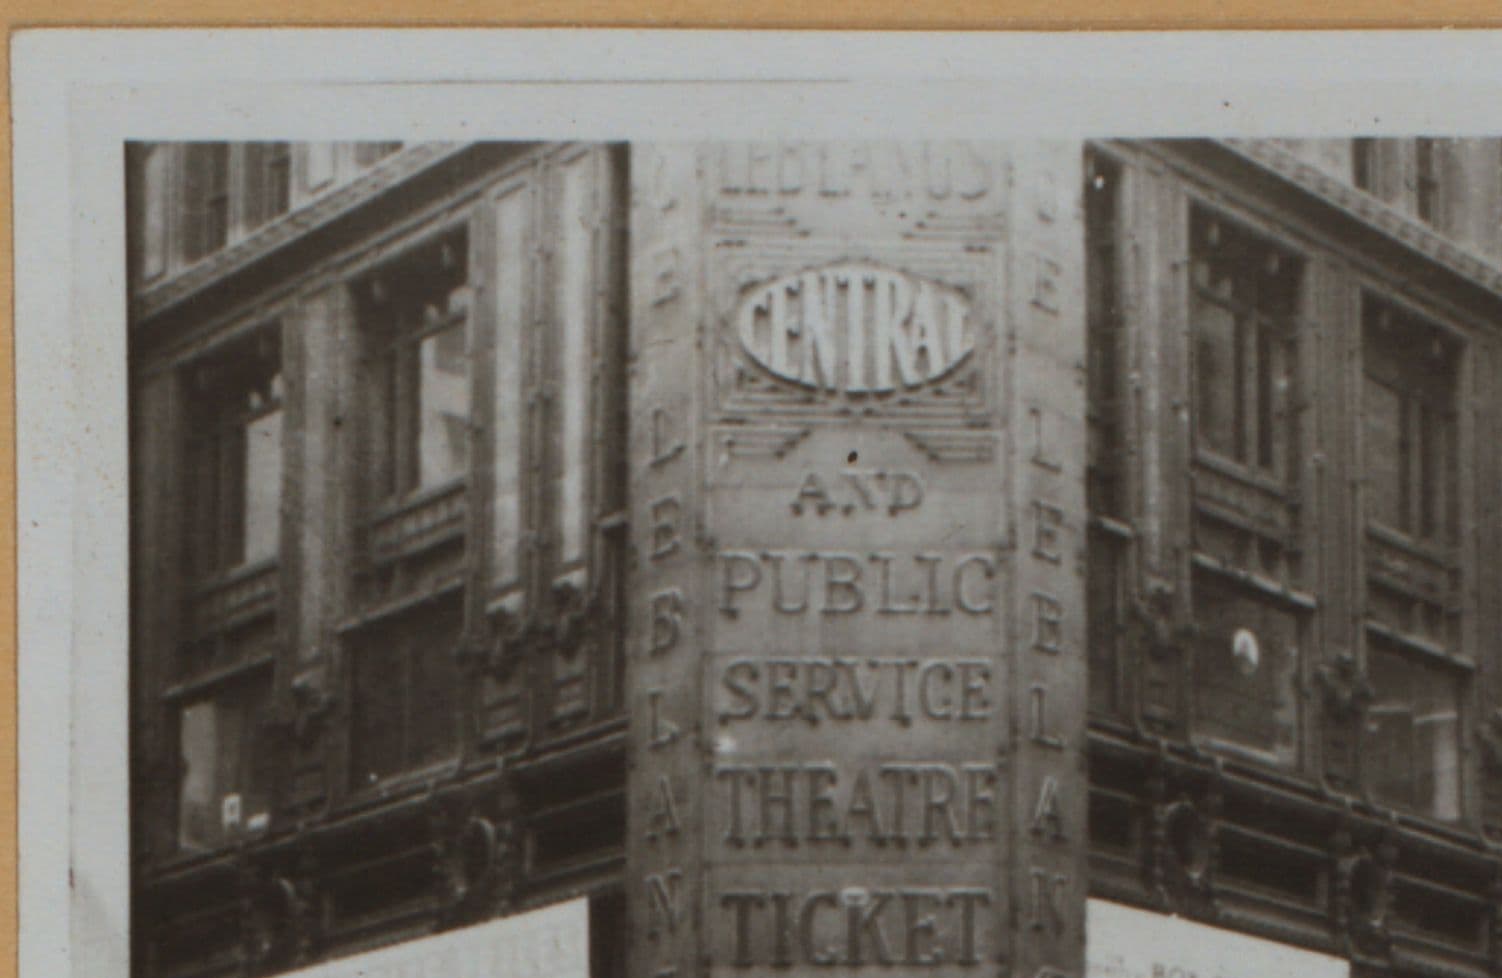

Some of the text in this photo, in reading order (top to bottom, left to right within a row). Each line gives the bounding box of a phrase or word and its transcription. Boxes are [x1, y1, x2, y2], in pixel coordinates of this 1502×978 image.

[736, 261, 976, 393] CENTRAL
[789, 469, 925, 517] AND
[715, 549, 998, 618] PUBLIC
[718, 656, 994, 728] SERVICE
[713, 762, 997, 850] THEATRE
[719, 886, 992, 969] TICKET
